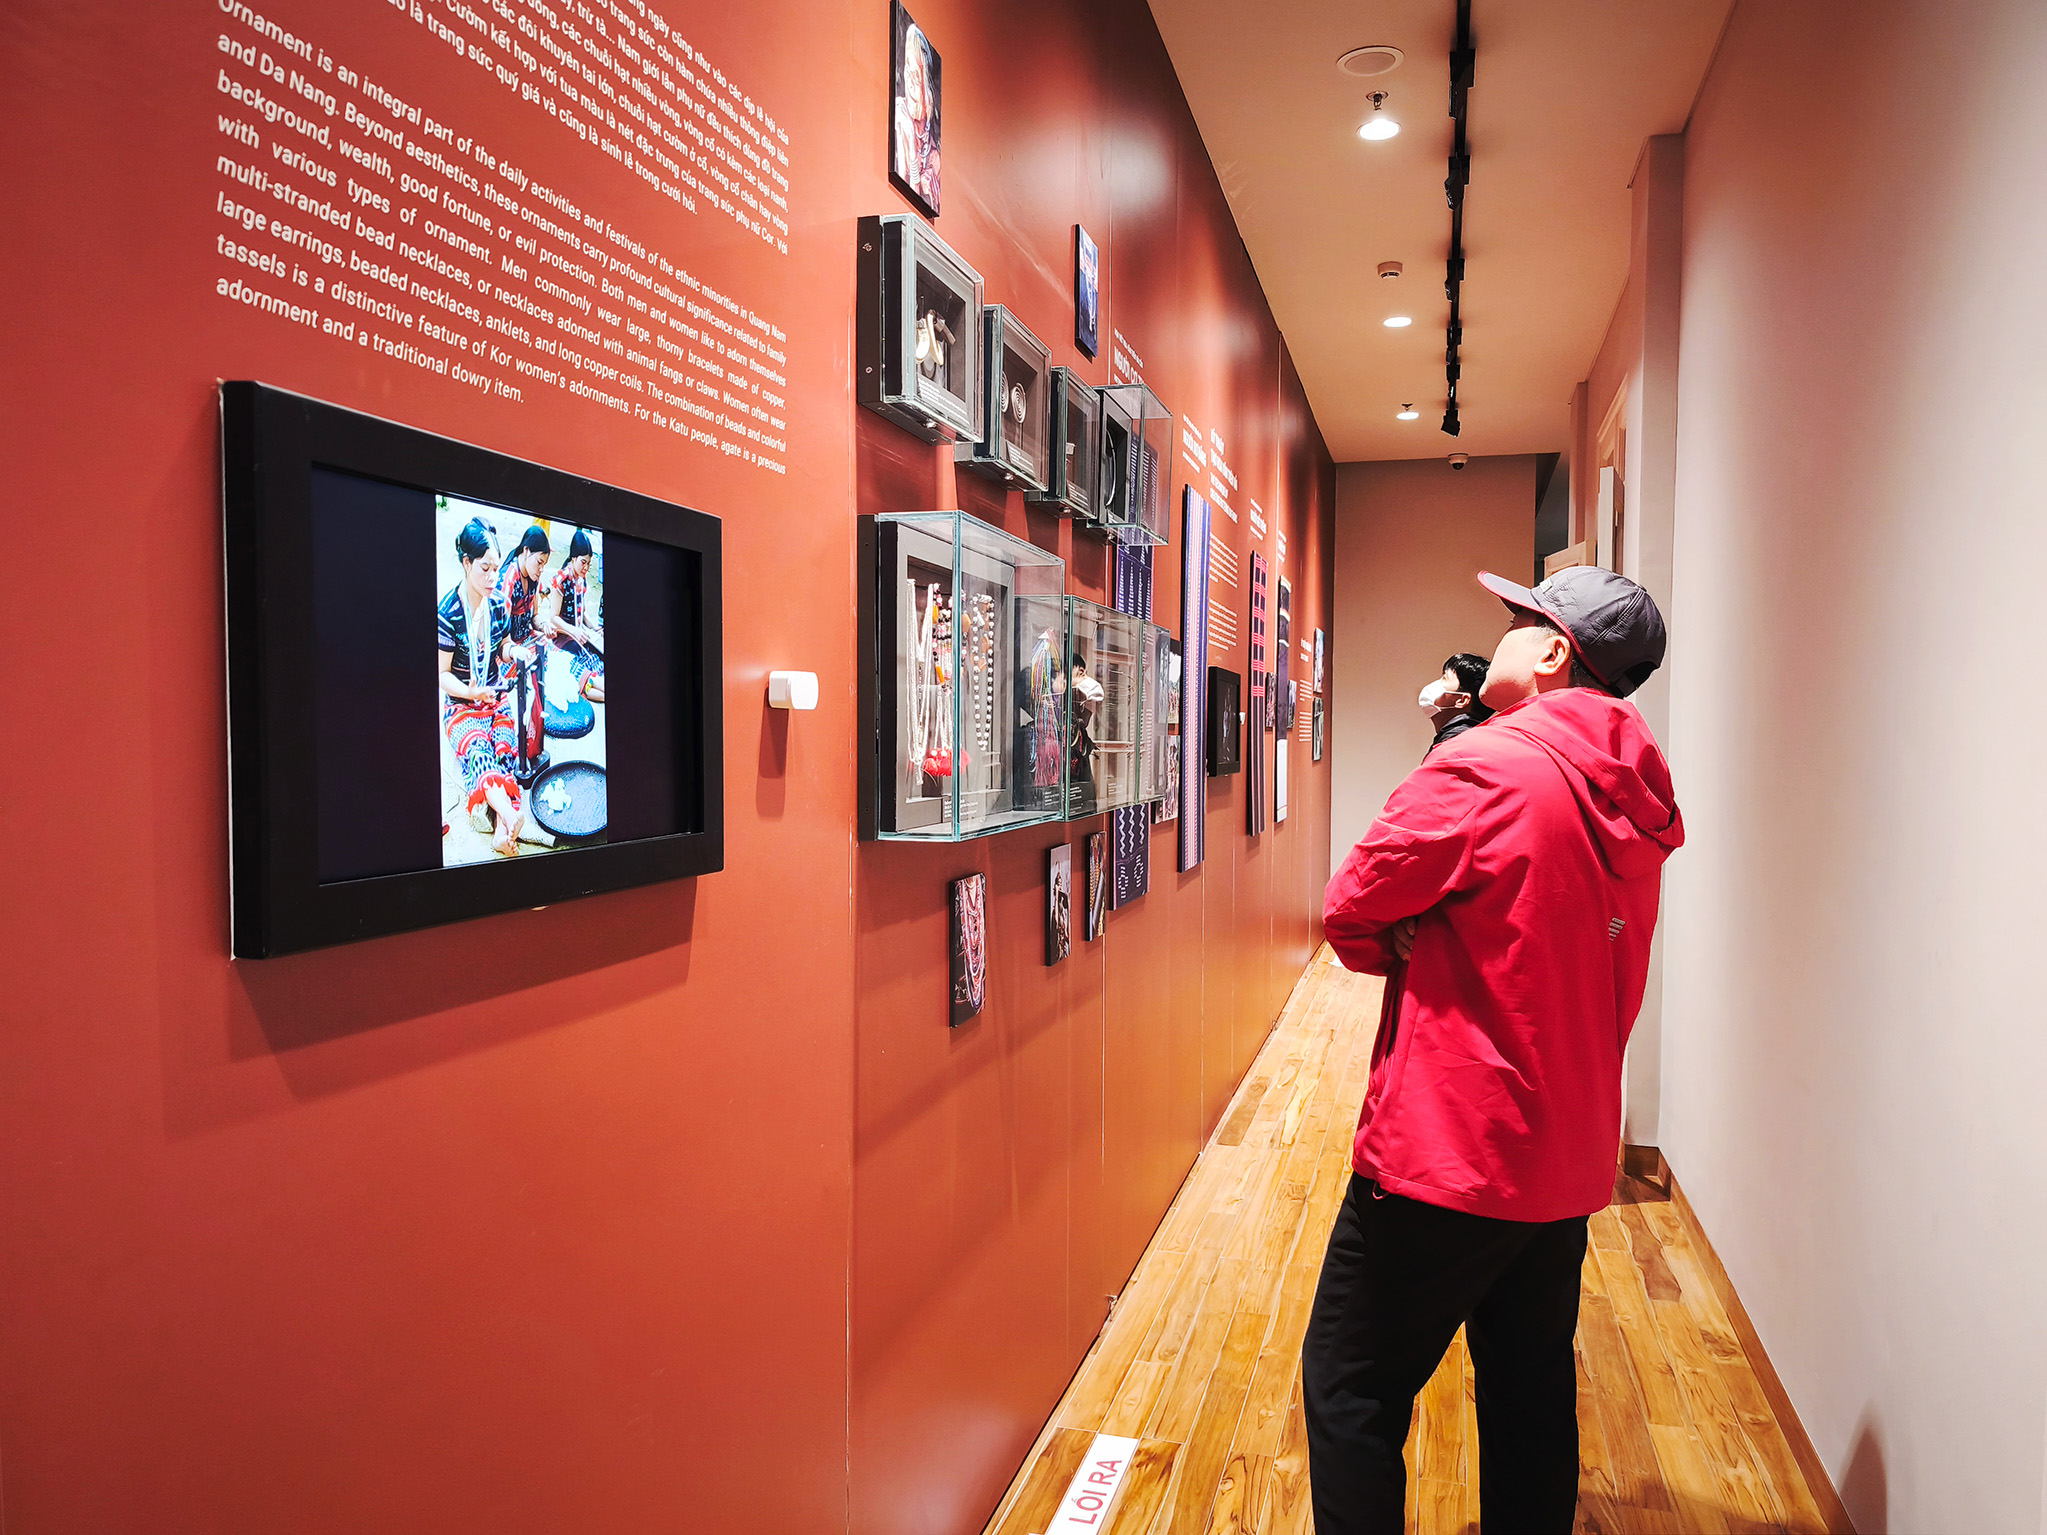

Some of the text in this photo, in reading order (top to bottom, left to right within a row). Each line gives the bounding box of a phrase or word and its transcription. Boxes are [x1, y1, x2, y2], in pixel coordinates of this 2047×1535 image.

[410, 0, 697, 215] là trang sức quý giá và cũng là sính lễ trong cưới hỏi.
[490, 22, 511, 53] kết
[514, 39, 537, 73] hợp
[539, 63, 557, 87] với
[559, 76, 578, 102] tua
[580, 93, 604, 121] màu
[606, 109, 616, 130] là
[618, 122, 634, 144] nét
[636, 133, 654, 157] đặc
[655, 148, 680, 179] trưng
[681, 169, 697, 189] của
[609, 0, 656, 51] trang sức
[617, 33, 641, 66] Nam
[217, 34, 787, 368] and Da Nang. Beyond aesthetics, these ornaments carry profound cultural significance related to family
[217, 69, 786, 387] background, wealth, good fortune, or evil protection. Both men and women like to adorn themselves
[218, 0, 786, 343] Ornament is an integral part of the daily activities and festivals of the ethnic minorities in Quang Nam
[218, 114, 786, 411] with various types of ornament. Men commonly wear large, thorny bracelets made of copper,
[216, 278, 524, 403] adornment and a traditional dowry item.
[217, 156, 786, 431] multi-stranded bead necklaces, or necklaces adorned with animal fangs or claws. Women often wear
[217, 191, 786, 453] large earrings, beaded necklaces, anklets, and long copper coils. The combination of beads and colorful
[217, 234, 286, 278] tassels
[292, 263, 308, 287] is
[314, 277, 325, 294] a
[331, 280, 413, 328] distinctive
[418, 314, 468, 350] feature
[472, 340, 487, 357] of
[489, 345, 513, 367] Kor
[569, 375, 631, 415] adornments.
[634, 403, 651, 421] For
[652, 408, 668, 428] the
[669, 417, 689, 437] Katu
[690, 428, 719, 450] people,
[720, 440, 742, 457] agate
[743, 446, 750, 461] is
[751, 449, 757, 463] a
[757, 455, 786, 475] precious
[1087, 1460, 1122, 1485] RA
